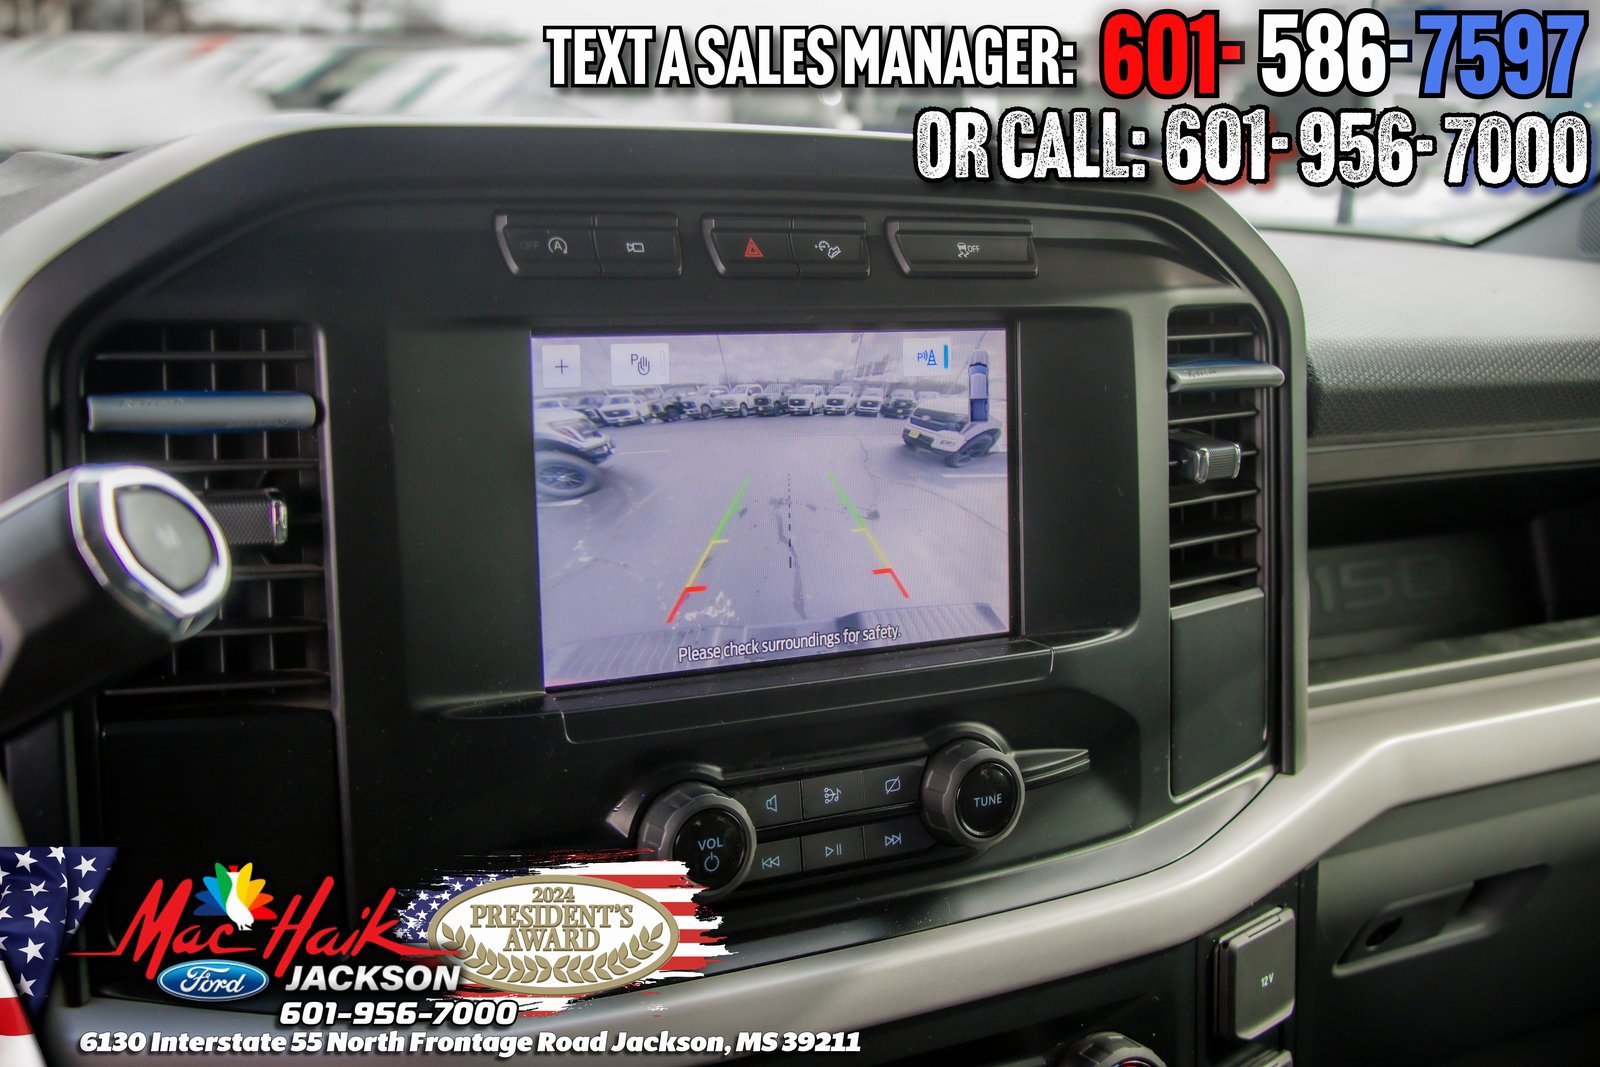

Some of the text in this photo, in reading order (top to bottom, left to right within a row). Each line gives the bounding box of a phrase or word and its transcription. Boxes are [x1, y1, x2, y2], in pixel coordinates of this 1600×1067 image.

[967, 245, 980, 253] OFF
[678, 624, 901, 663] Please check surroundings for safety.
[974, 793, 1003, 808] TUNE
[698, 837, 724, 851] VOL
